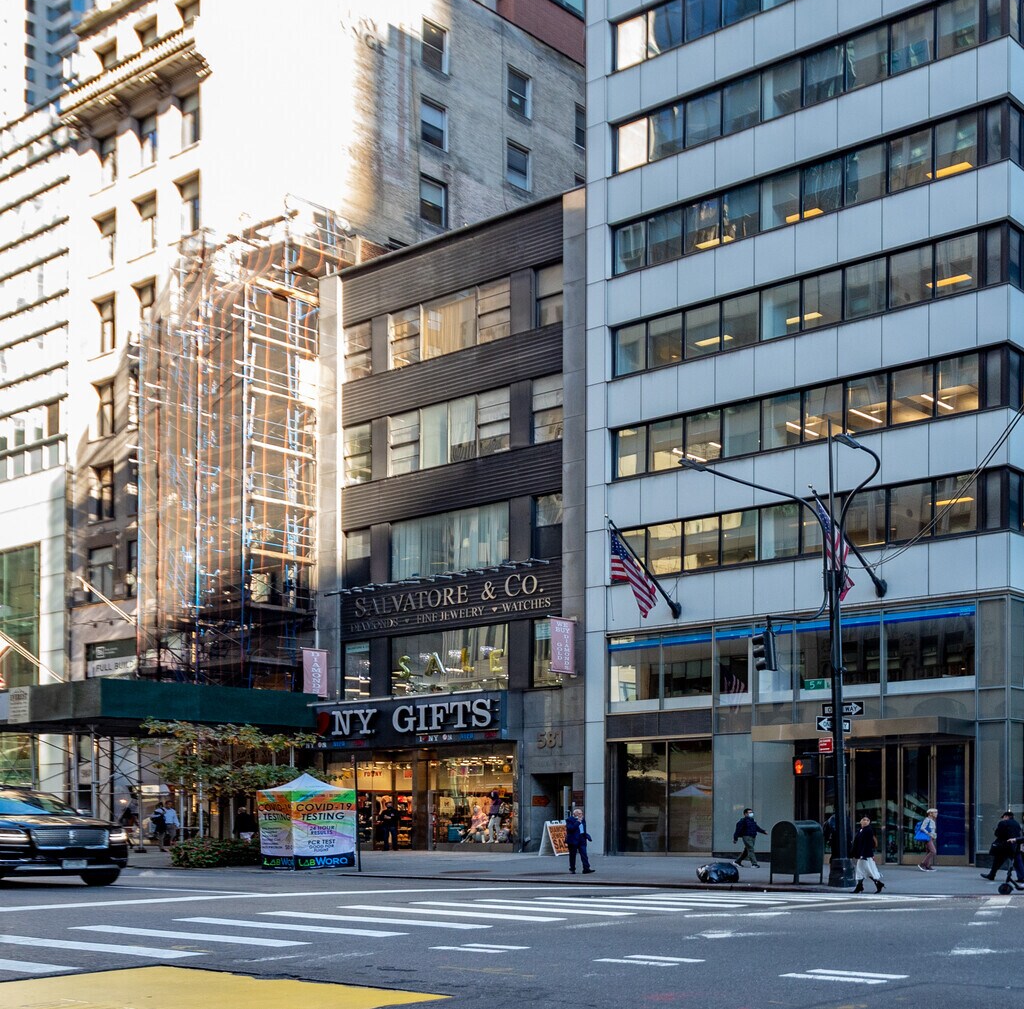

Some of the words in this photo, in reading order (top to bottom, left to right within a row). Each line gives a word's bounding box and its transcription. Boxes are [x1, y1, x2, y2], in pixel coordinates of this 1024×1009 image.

[355, 585, 469, 618] SALVATORE
[481, 580, 497, 600] &
[417, 614, 437, 624] FINE
[439, 606, 485, 622] JEWELRY
[502, 597, 551, 613] WATCHES
[96, 664, 112, 672] FULL
[398, 647, 503, 679] SALE
[809, 681, 815, 689] 5
[392, 698, 492, 733] GIFTS
[537, 731, 563, 748] 581
[296, 802, 352, 812] COVID-19
[302, 812, 345, 821] TESTING
